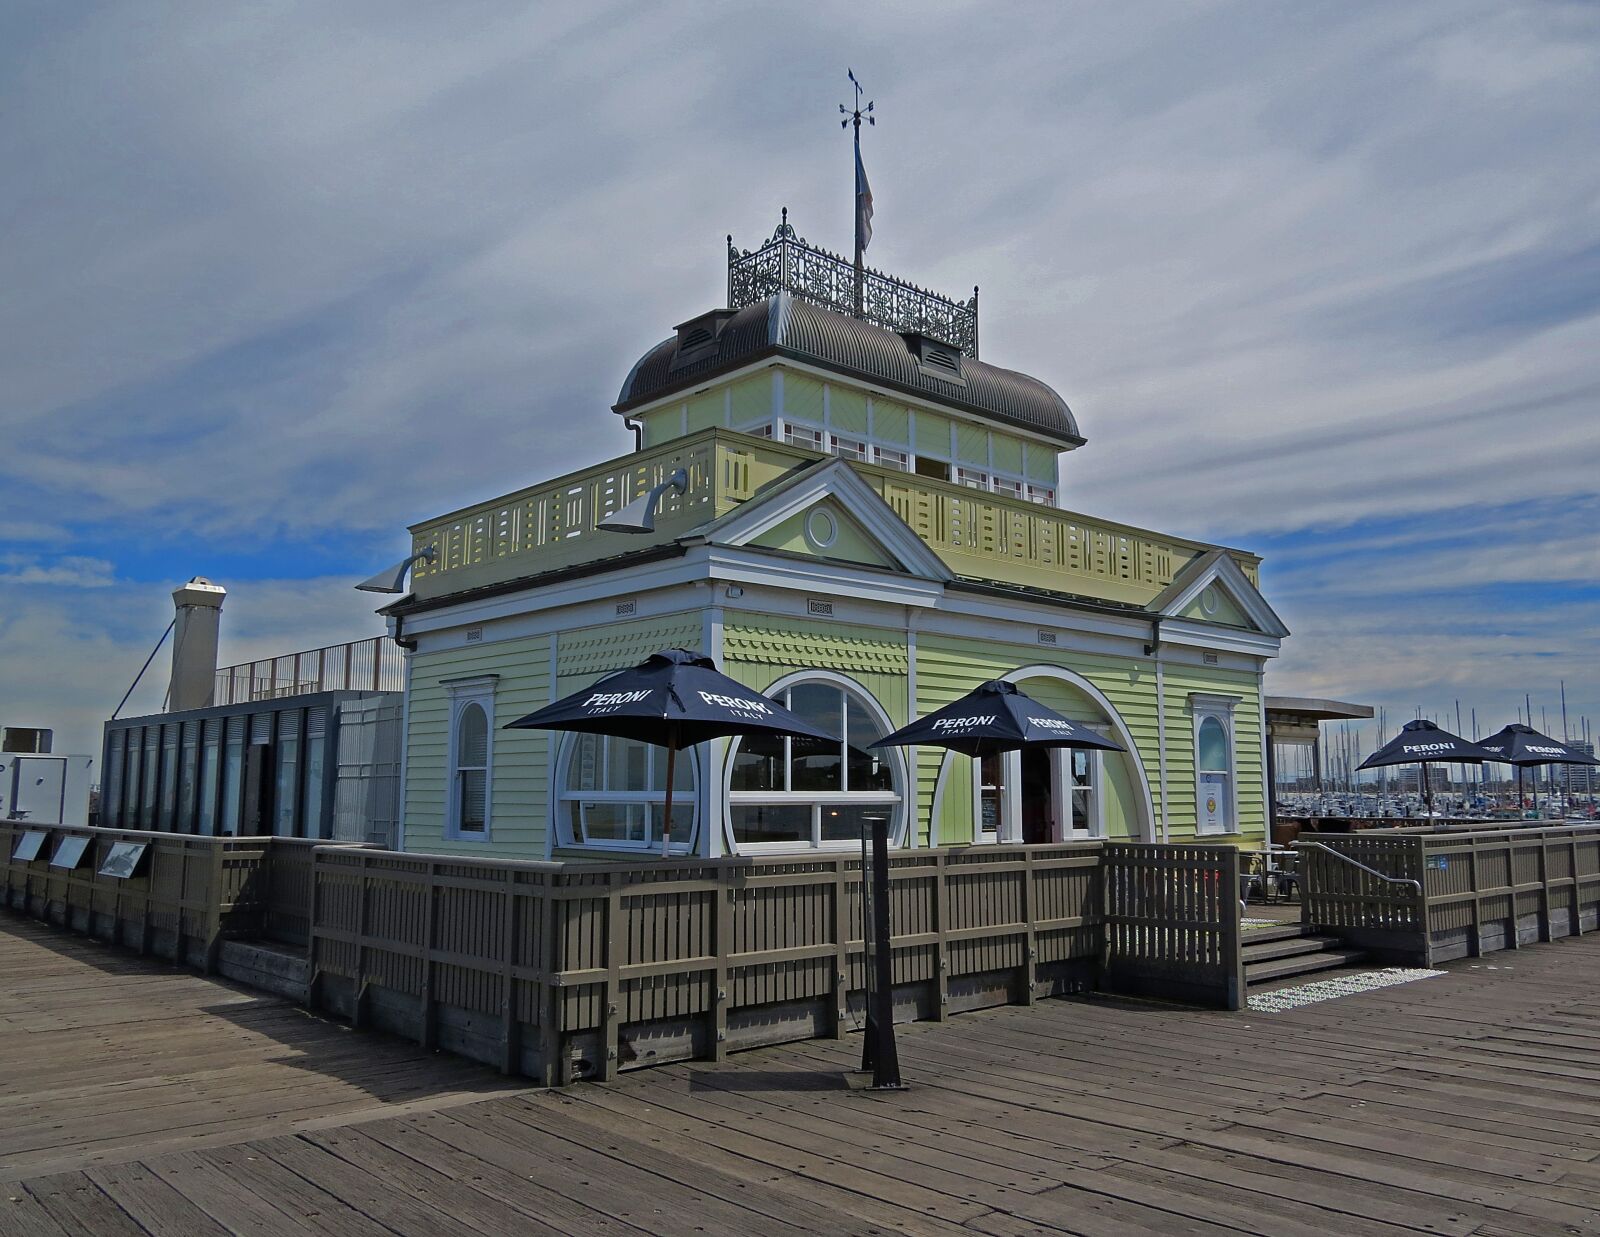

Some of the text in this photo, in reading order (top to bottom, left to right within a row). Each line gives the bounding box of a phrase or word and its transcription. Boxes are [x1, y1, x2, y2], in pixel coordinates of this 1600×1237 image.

[582, 690, 653, 706] PERONI
[697, 690, 774, 715] PERONI
[588, 705, 622, 714] ITALY
[730, 709, 764, 720] ITALY
[931, 715, 997, 730] PERONI
[1027, 716, 1075, 731] PERONI
[942, 727, 974, 735] ITALY
[1403, 742, 1456, 753] PERONI
[1525, 745, 1568, 755] PERONI
